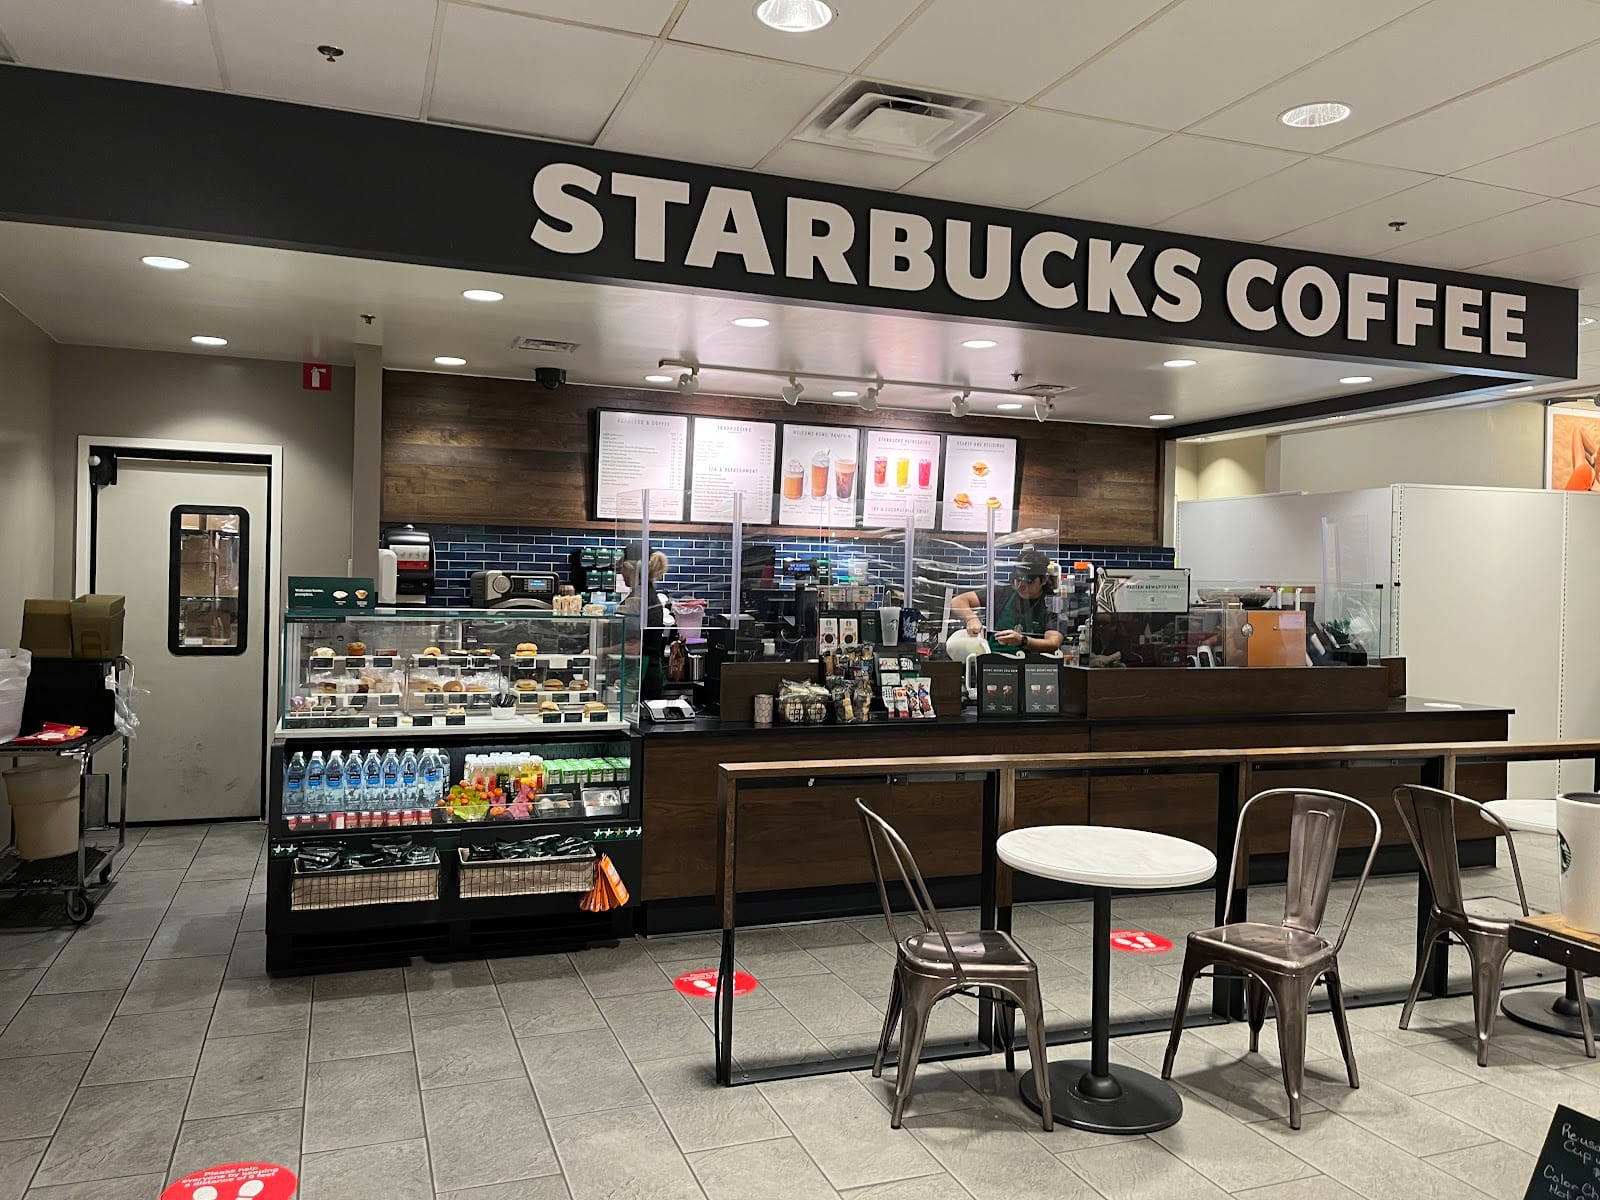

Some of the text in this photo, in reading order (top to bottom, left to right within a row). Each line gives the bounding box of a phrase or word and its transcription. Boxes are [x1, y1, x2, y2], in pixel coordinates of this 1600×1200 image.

[530, 163, 1527, 358] STARBUCKS COFFEE
[1563, 1140, 1592, 1165] Cup
[181, 1174, 226, 1183] everyone
[241, 1167, 279, 1177] keeping
[193, 1177, 234, 1186] distance
[204, 1169, 236, 1177] Please
[1543, 1164, 1579, 1190] Color
